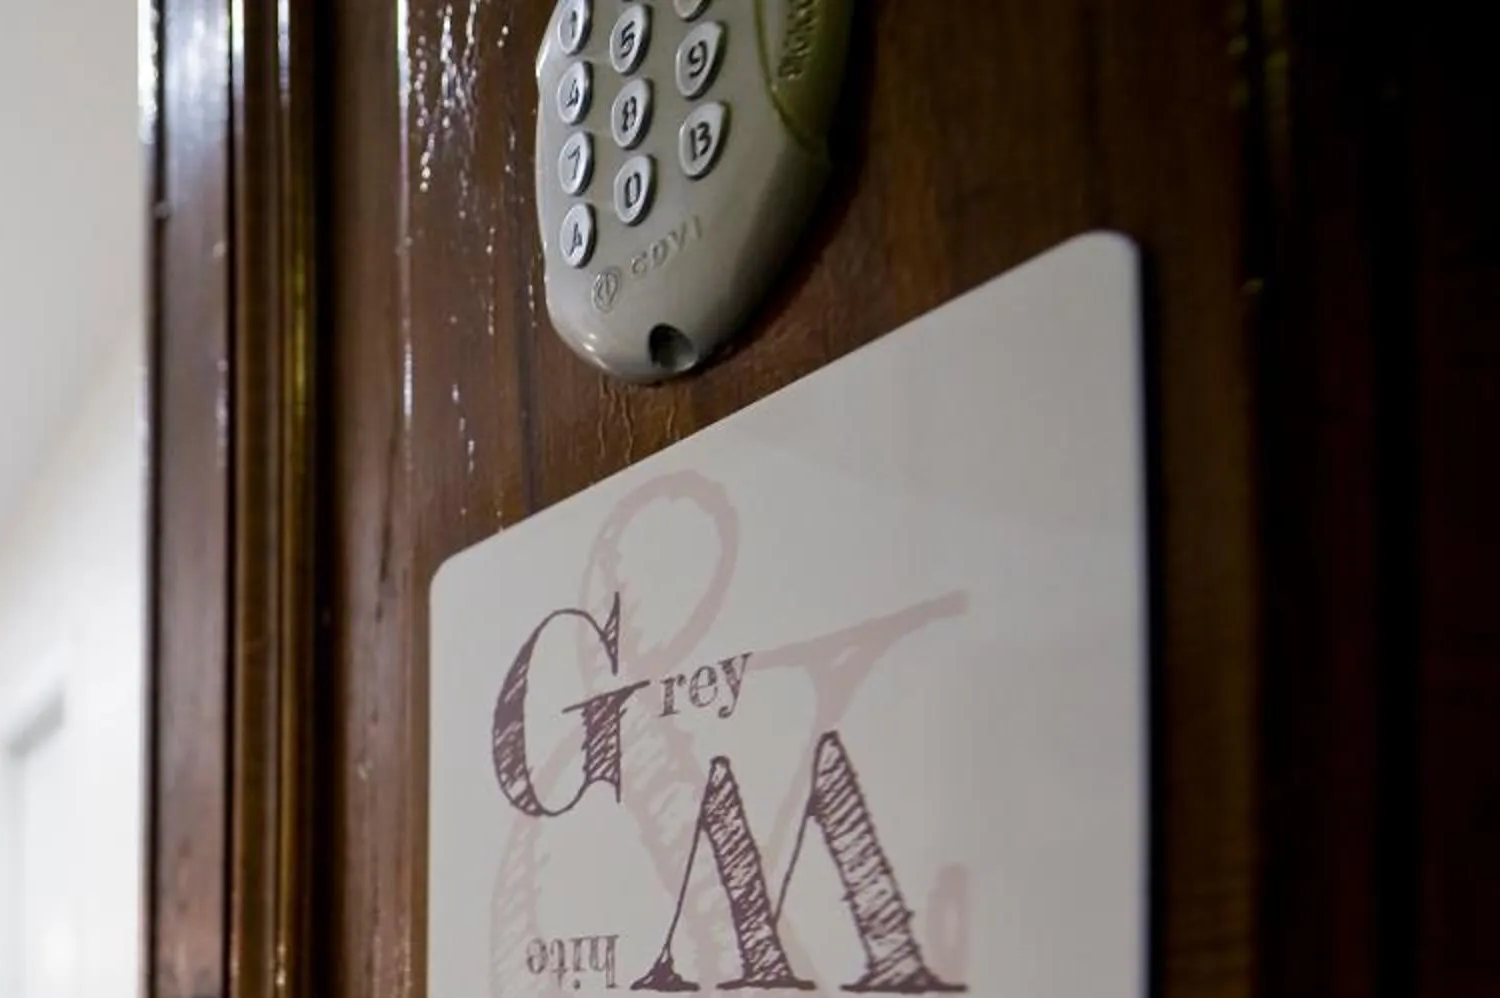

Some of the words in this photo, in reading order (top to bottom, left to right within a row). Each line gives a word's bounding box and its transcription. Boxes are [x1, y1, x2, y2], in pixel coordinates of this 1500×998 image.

[620, 19, 636, 59] 5
[687, 39, 708, 79] 9
[621, 95, 638, 133] 8
[689, 121, 712, 162] B
[567, 145, 581, 181] 7
[493, 591, 752, 817] Grey
